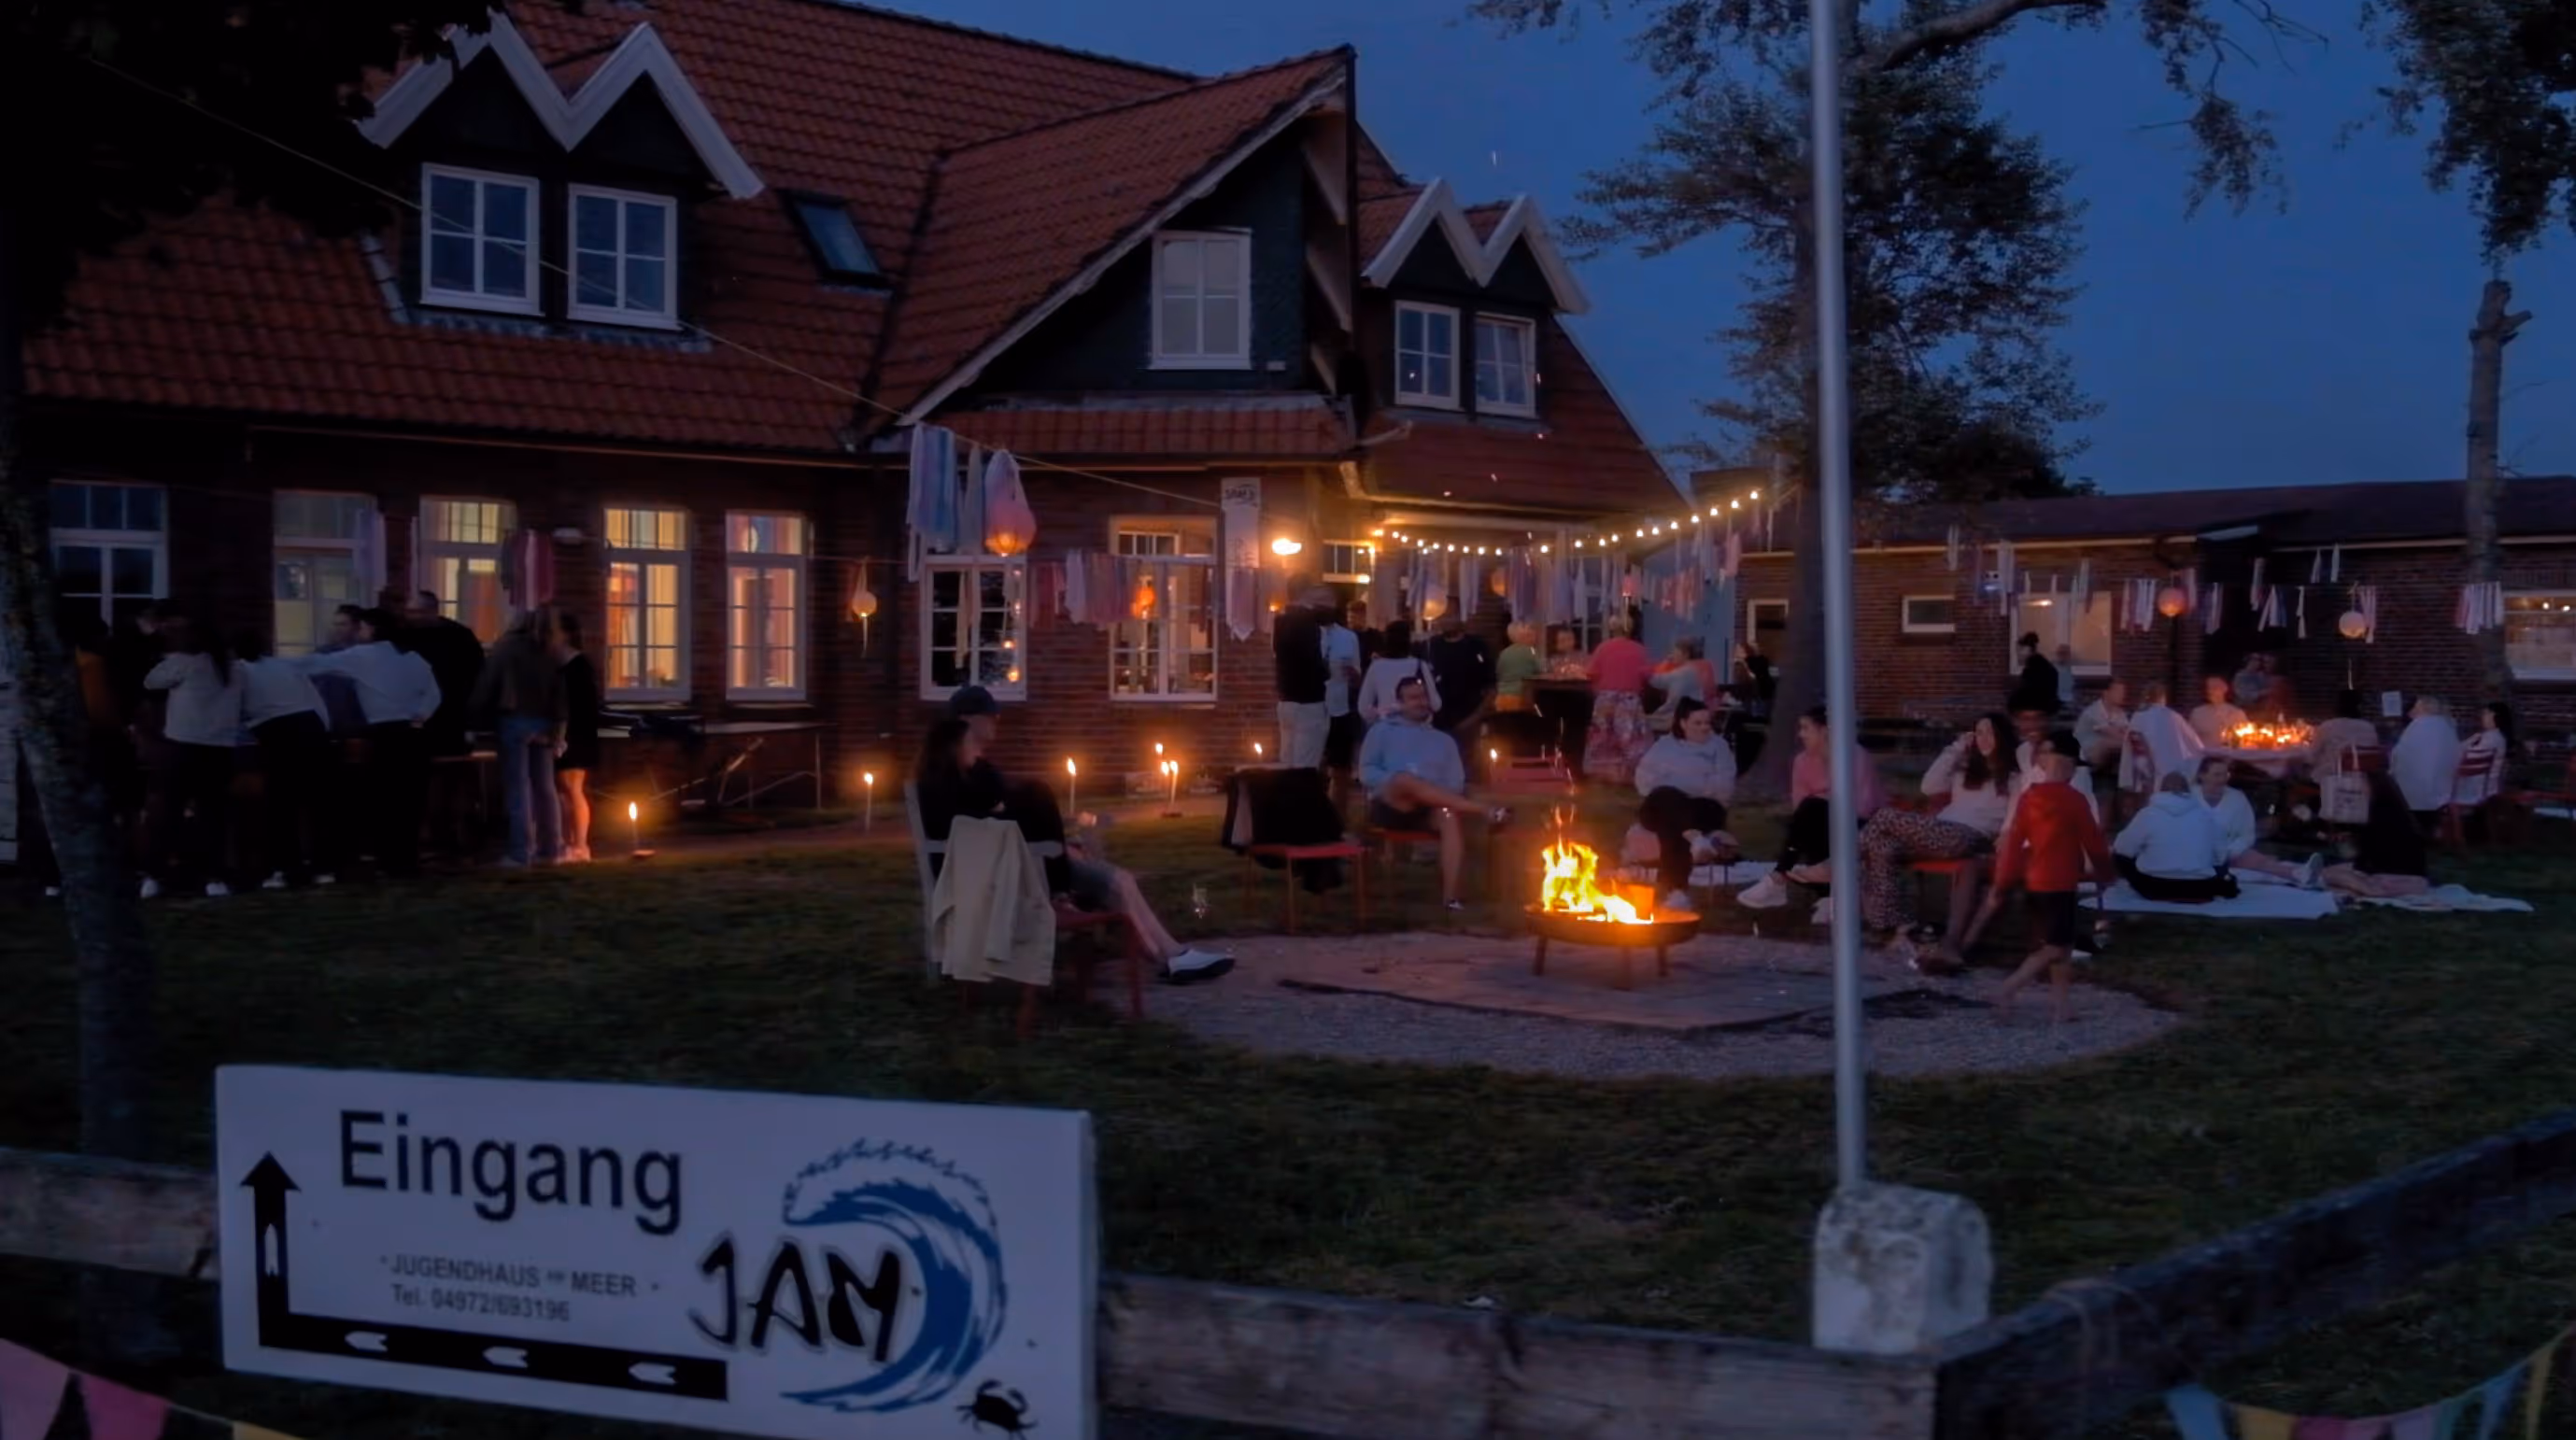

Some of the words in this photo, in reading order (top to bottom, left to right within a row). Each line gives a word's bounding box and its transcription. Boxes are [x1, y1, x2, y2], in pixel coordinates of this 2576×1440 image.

[340, 1109, 681, 1235] Eingang
[391, 1253, 540, 1288] JUGENDHAUS
[572, 1270, 637, 1297] MEER
[391, 1283, 424, 1306] Tel.
[690, 1235, 902, 1362] JAM
